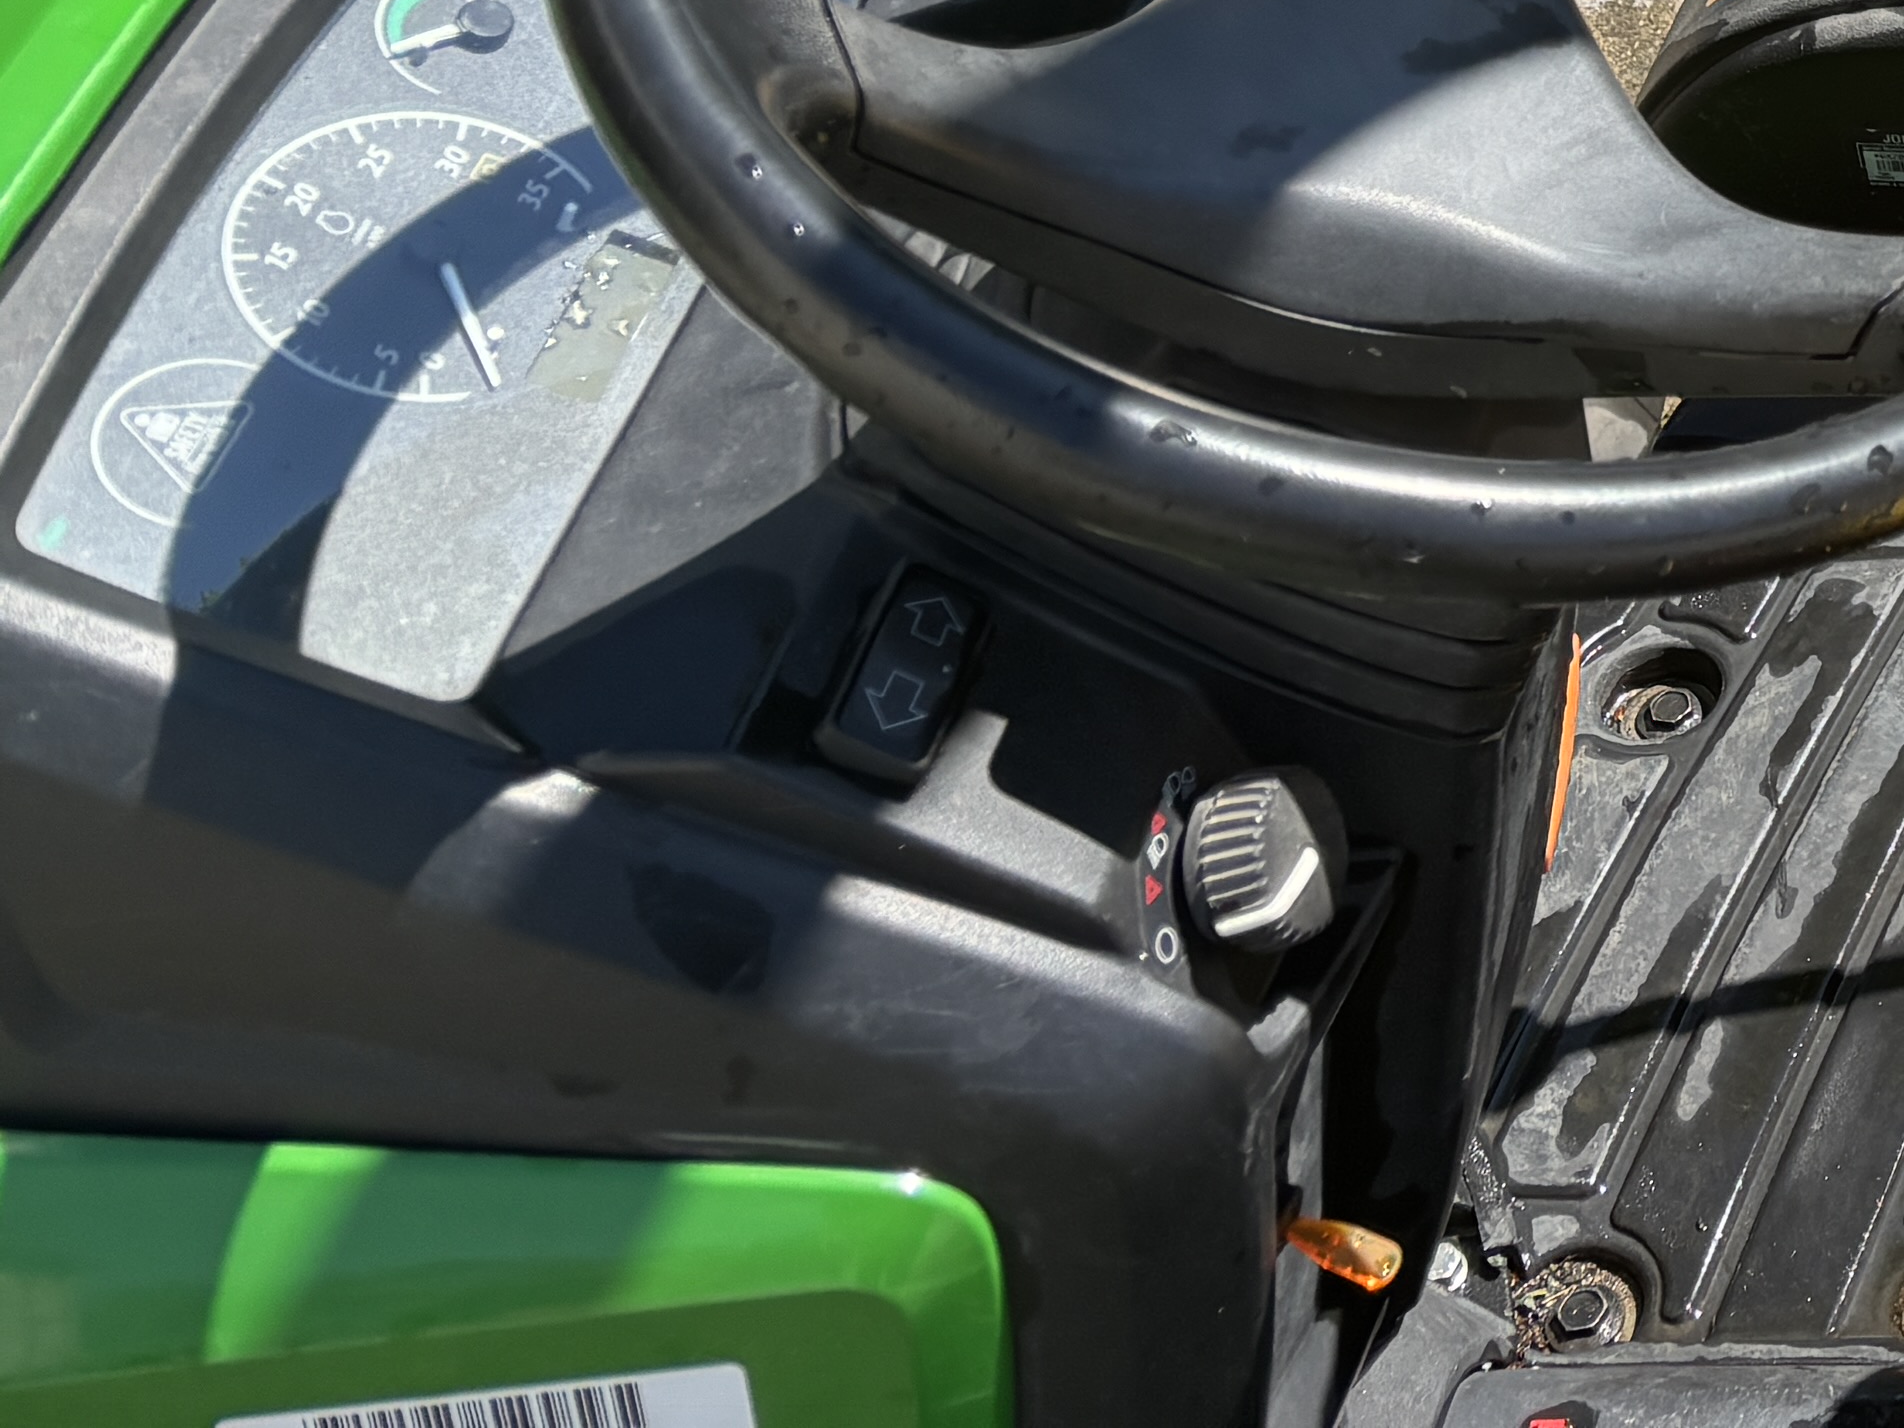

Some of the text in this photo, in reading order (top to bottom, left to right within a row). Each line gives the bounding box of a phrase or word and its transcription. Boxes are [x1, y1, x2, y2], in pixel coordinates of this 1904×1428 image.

[357, 144, 394, 179] 25
[434, 146, 470, 179] 30
[284, 182, 321, 217] 20
[517, 179, 550, 211] 35
[264, 242, 299, 270] 15
[297, 299, 331, 326] 10
[374, 345, 399, 366] 5
